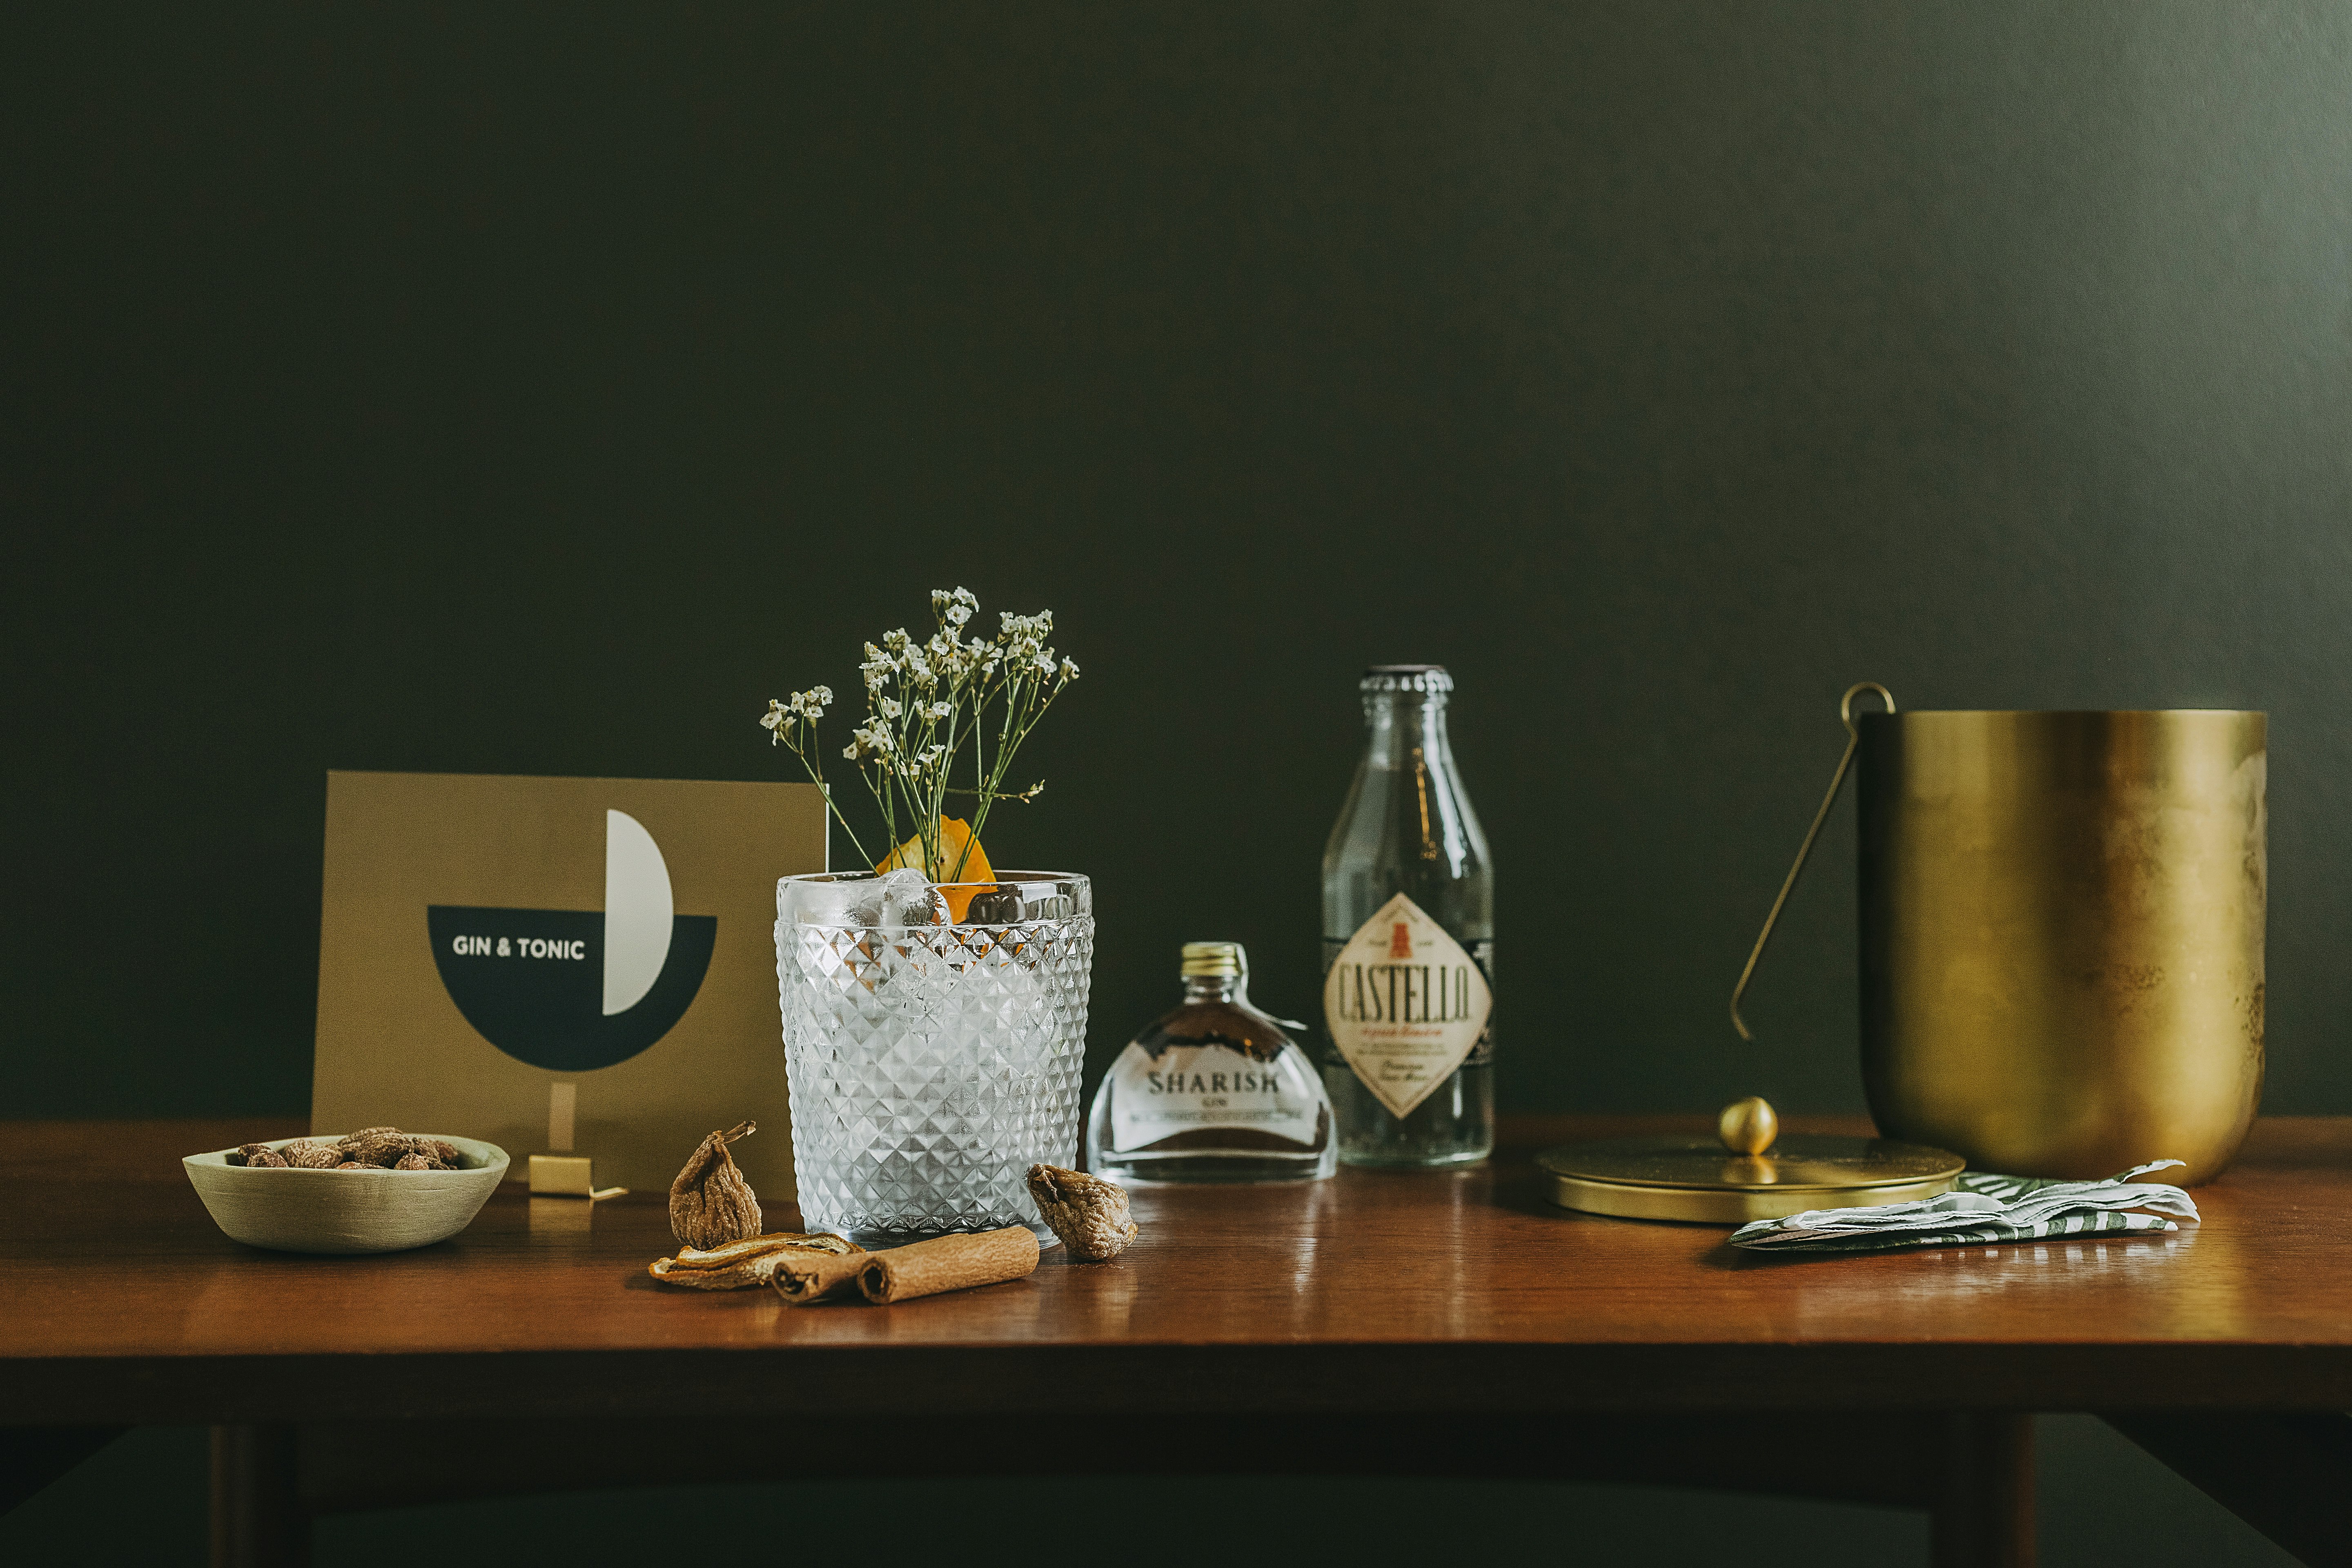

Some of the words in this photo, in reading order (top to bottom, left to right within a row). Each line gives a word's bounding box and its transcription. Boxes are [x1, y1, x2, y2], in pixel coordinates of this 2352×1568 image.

[452, 935, 491, 957] GIN
[496, 937, 511, 957] &
[517, 937, 585, 960] TONIC
[1339, 963, 1470, 1024] CASTELLO
[1147, 1071, 1278, 1094] SHARISH
